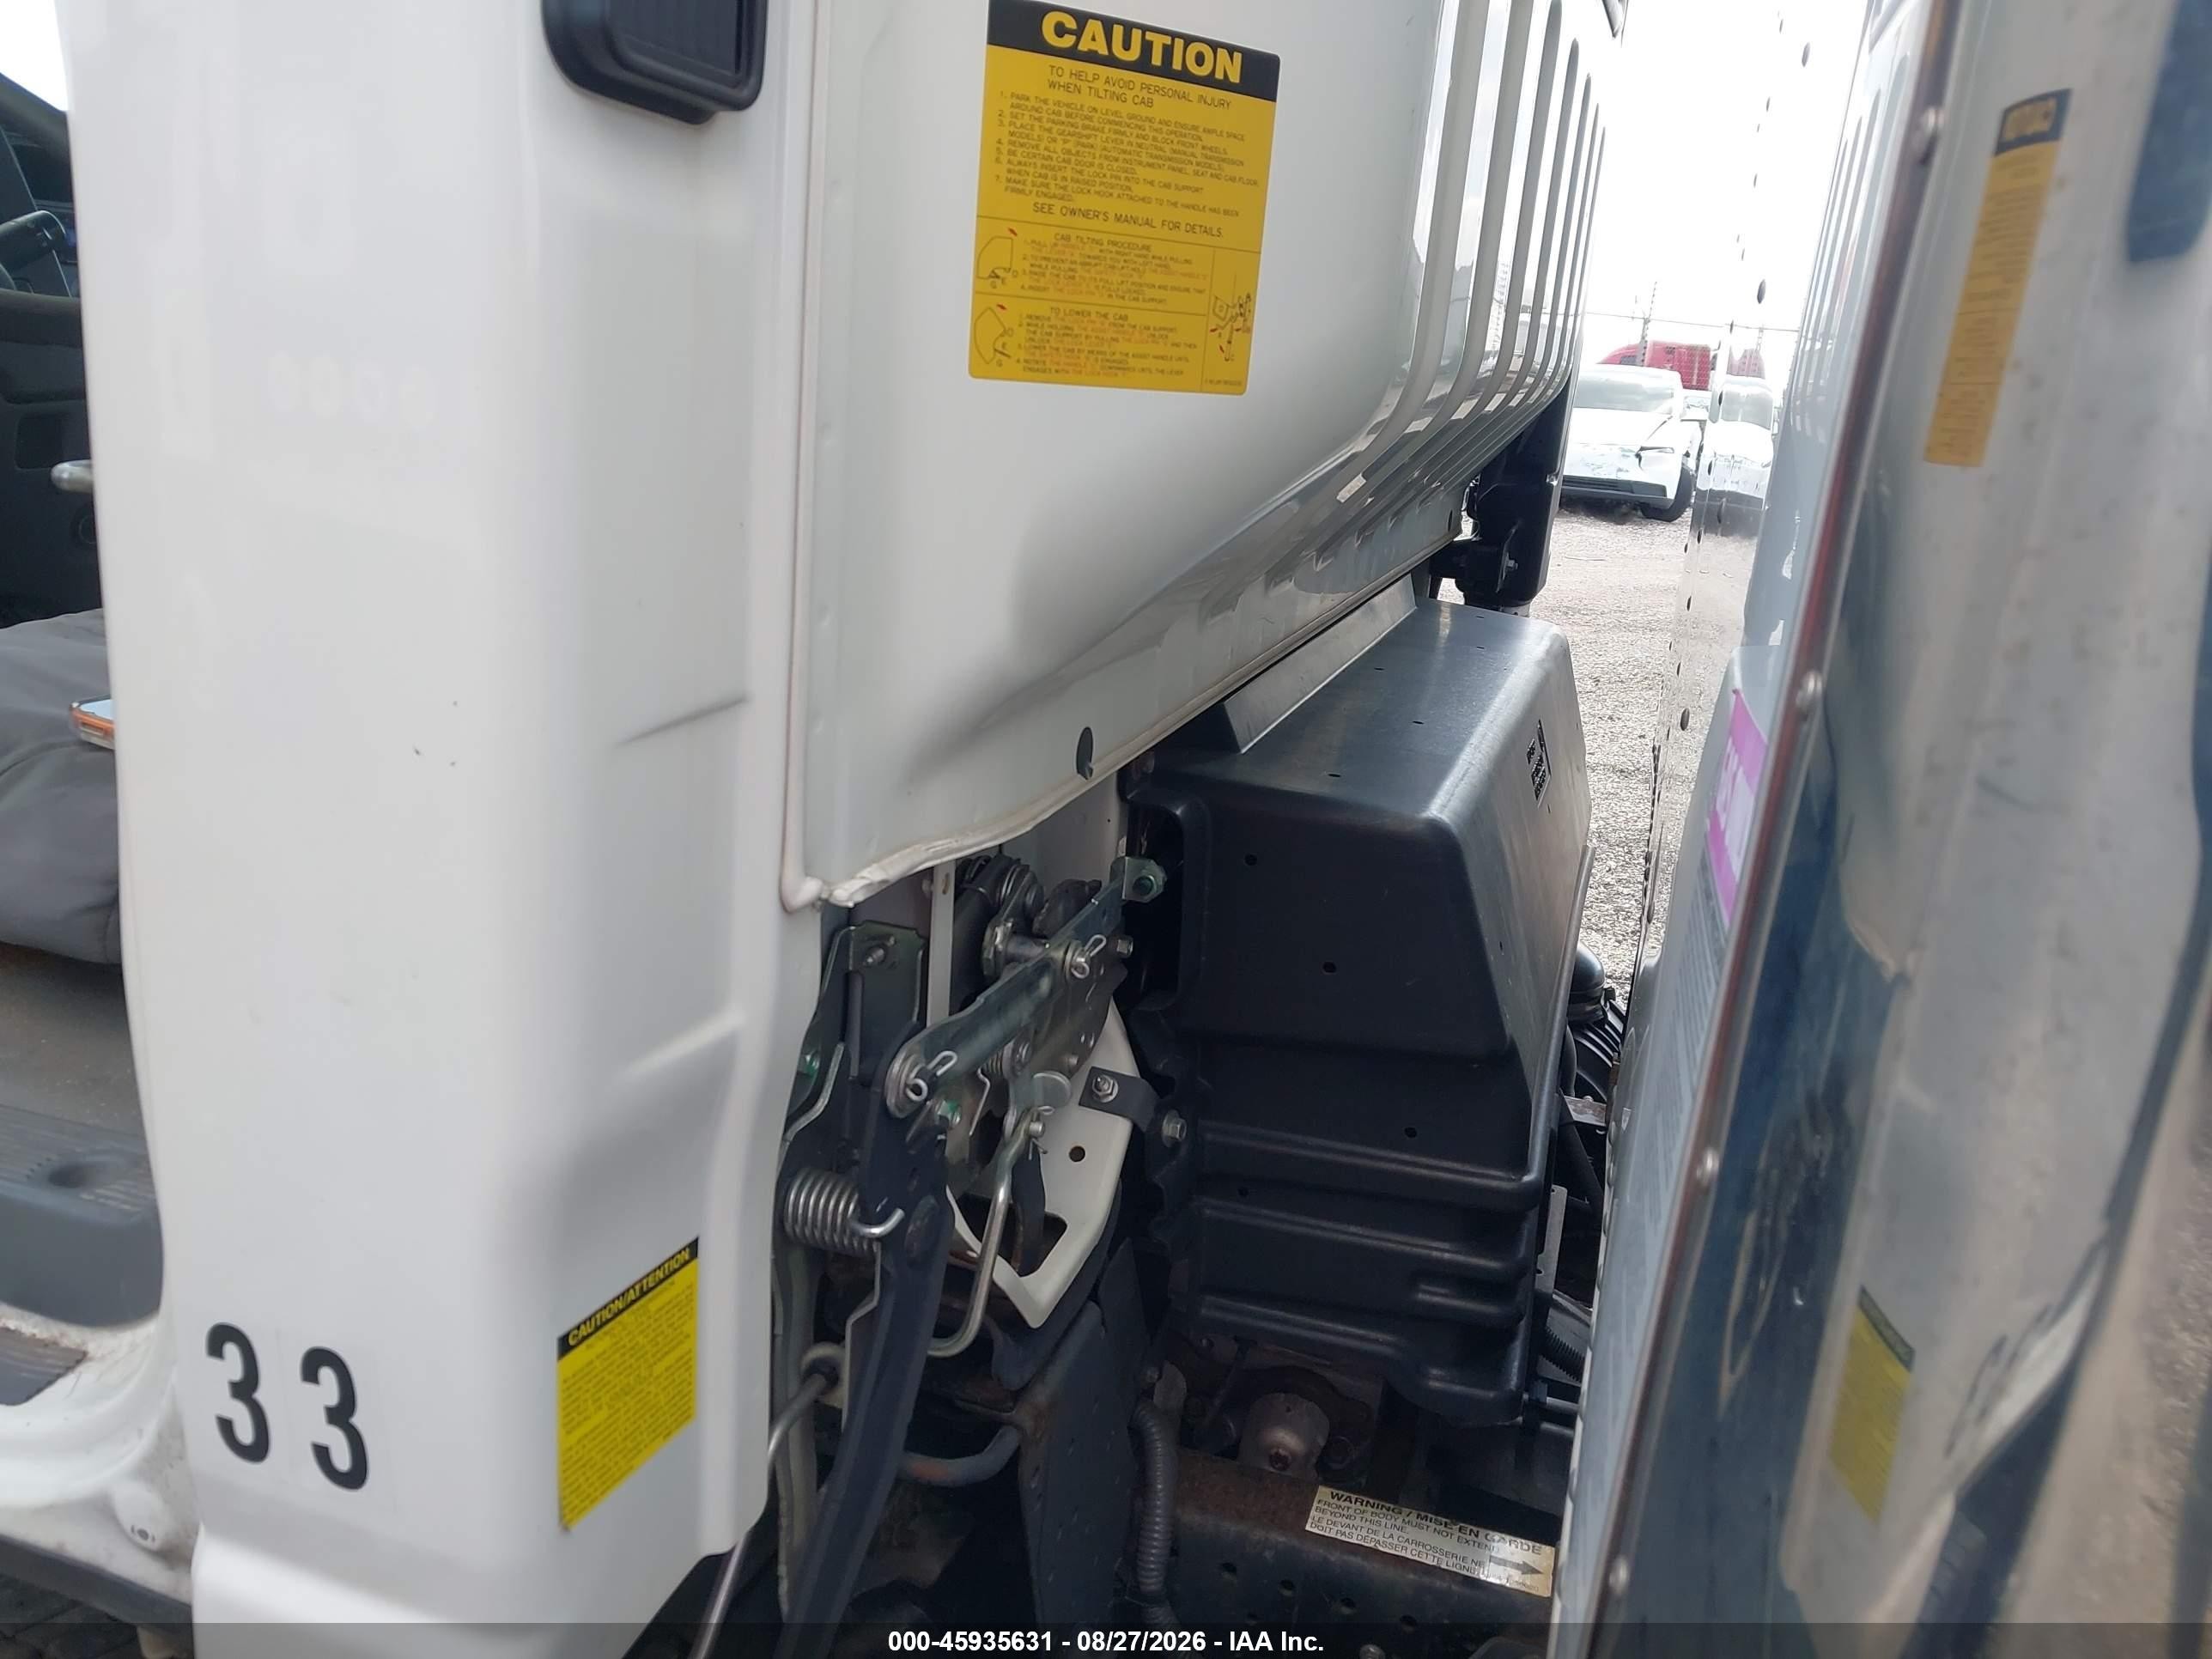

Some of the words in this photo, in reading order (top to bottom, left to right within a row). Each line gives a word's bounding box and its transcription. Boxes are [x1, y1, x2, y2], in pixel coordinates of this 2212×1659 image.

[1042, 10, 1242, 83] CAUTION
[1048, 65, 1064, 77] TO
[1070, 69, 1100, 84] HELP
[1104, 76, 1135, 91] AVOID
[1140, 82, 1194, 102] PERSONAL
[1198, 94, 1231, 110] INJURY
[1048, 79, 1081, 94] WHEN
[1088, 87, 1127, 103] TILTING
[1133, 95, 1154, 108] CAB
[1010, 101, 1043, 114] AROUND
[1046, 107, 1062, 117] CAB
[1065, 111, 1094, 123] BEFORE
[1097, 117, 1146, 131] COMMENCING
[1149, 125, 1164, 135] THIS
[1010, 111, 1024, 120] SET
[1030, 114, 1043, 124] THE
[1047, 117, 1079, 130] PARKING
[1081, 123, 1105, 134] BRAKE
[1109, 128, 1133, 138] FIRMLY
[1135, 132, 1150, 142] AND
[1152, 136, 1174, 146] BLOCK
[1177, 140, 1199, 149] FRONT
[1011, 92, 1030, 102] PARK
[1035, 96, 1048, 106] THE
[1052, 100, 1085, 112] VEHICLE
[1087, 106, 1098, 114] ON
[1101, 108, 1123, 118] LEVEL
[1127, 113, 1155, 125] GROUND
[1158, 118, 1172, 127] AND
[1175, 122, 1200, 132] ENSURE
[1203, 126, 1224, 137] AMPLE
[1225, 131, 1244, 141] SPACE
[1006, 167, 1030, 177] WHEN
[1033, 171, 1048, 180] CAB
[1072, 177, 1097, 187] RAISED
[1007, 158, 1037, 169] ALWAYS
[1041, 163, 1066, 173] INSERT
[1072, 167, 1085, 177] THE
[1088, 170, 1107, 179] LOCK
[1110, 173, 1121, 182] PIN
[1124, 176, 1140, 185] INTO
[1143, 179, 1155, 187] THE
[1158, 181, 1171, 190] CAB
[1175, 184, 1203, 195] SUPPORT
[1021, 150, 1054, 162] CERTAIN
[1056, 156, 1072, 165] CAB
[1075, 159, 1095, 169] DOOR
[1006, 176, 1027, 186] MAKE
[1031, 179, 1050, 190] SURE
[1054, 184, 1069, 192] THE
[1072, 186, 1091, 196] LOCK
[1094, 189, 1114, 199] HOOK
[1117, 192, 1152, 204] ATTACHED
[1166, 200, 1179, 209] THE
[1181, 202, 1206, 212] HANDLE
[1209, 206, 1221, 215] HAS
[1223, 209, 1239, 217] BEEN
[1033, 202, 1054, 215] SEE
[1060, 205, 1109, 222] OWNER'S
[1115, 213, 1158, 228] MANUAL
[1162, 220, 1182, 232] FOR
[1185, 223, 1224, 237] DETAILS.
[1054, 233, 1071, 242] CAB
[1074, 235, 1104, 246] TILTING
[1108, 240, 1152, 252] PROCEDURE
[1064, 308, 1091, 318] LOWER
[568, 1248, 690, 1346] CAUTION/ATTENTION
[205, 1322, 368, 1491] 33
[1315, 1506, 1357, 1522] BEYOND
[1359, 1516, 1382, 1527] THIS
[1385, 1522, 1409, 1534] LINE.
[1317, 1499, 1352, 1512] FRONT
[1354, 1508, 1368, 1516] OF
[1370, 1510, 1399, 1523] BODY
[1401, 1519, 1430, 1531] MUST
[1433, 1528, 1455, 1539] NOT
[1329, 1492, 1403, 1516] WARNING
[1416, 1514, 1454, 1529] MISE
[1459, 1525, 1480, 1537] EN
[1310, 1522, 1335, 1534] DOIT
[1335, 1528, 1354, 1539] PAS
[1410, 1548, 1443, 1565] CETTE
[1326, 1517, 1364, 1534] DEVANT
[1367, 1528, 1380, 1536] DE
[1396, 1536, 1469, 1563] CARROSSERIE
